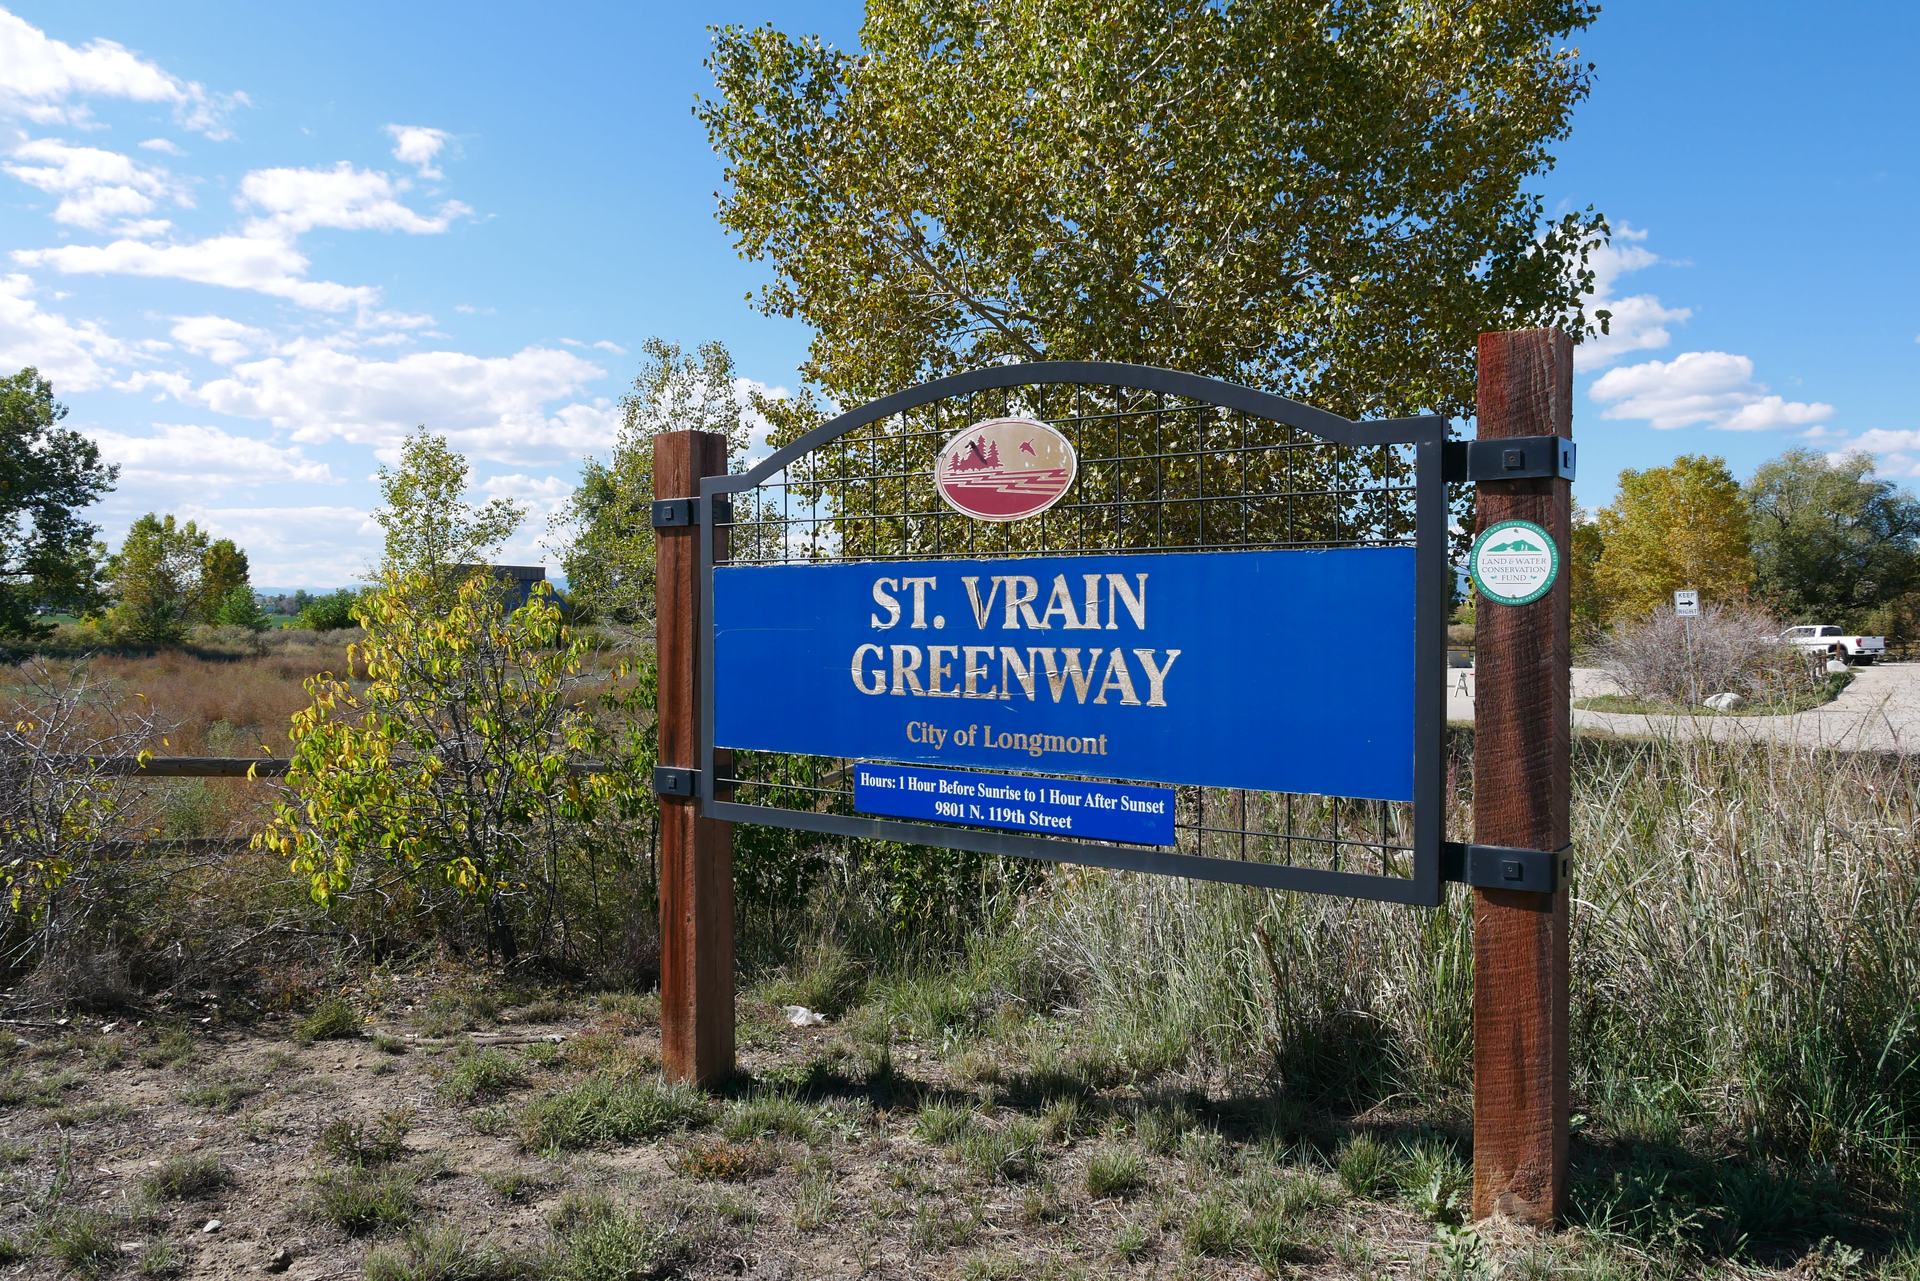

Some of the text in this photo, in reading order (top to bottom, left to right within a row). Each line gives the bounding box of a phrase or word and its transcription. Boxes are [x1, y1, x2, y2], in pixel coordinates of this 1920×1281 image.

[1501, 574, 1527, 582] FUND
[1515, 557, 1547, 565] WATER
[870, 573, 1149, 632] ST. VRAIN
[850, 643, 1182, 708] GREENWAY
[906, 720, 1108, 757] City of Longmont
[860, 772, 1165, 814] Hours: 1 Hour Before Sunrise to 1 Hour After Sunset
[934, 800, 1073, 829] 9801 N. 119th Street
